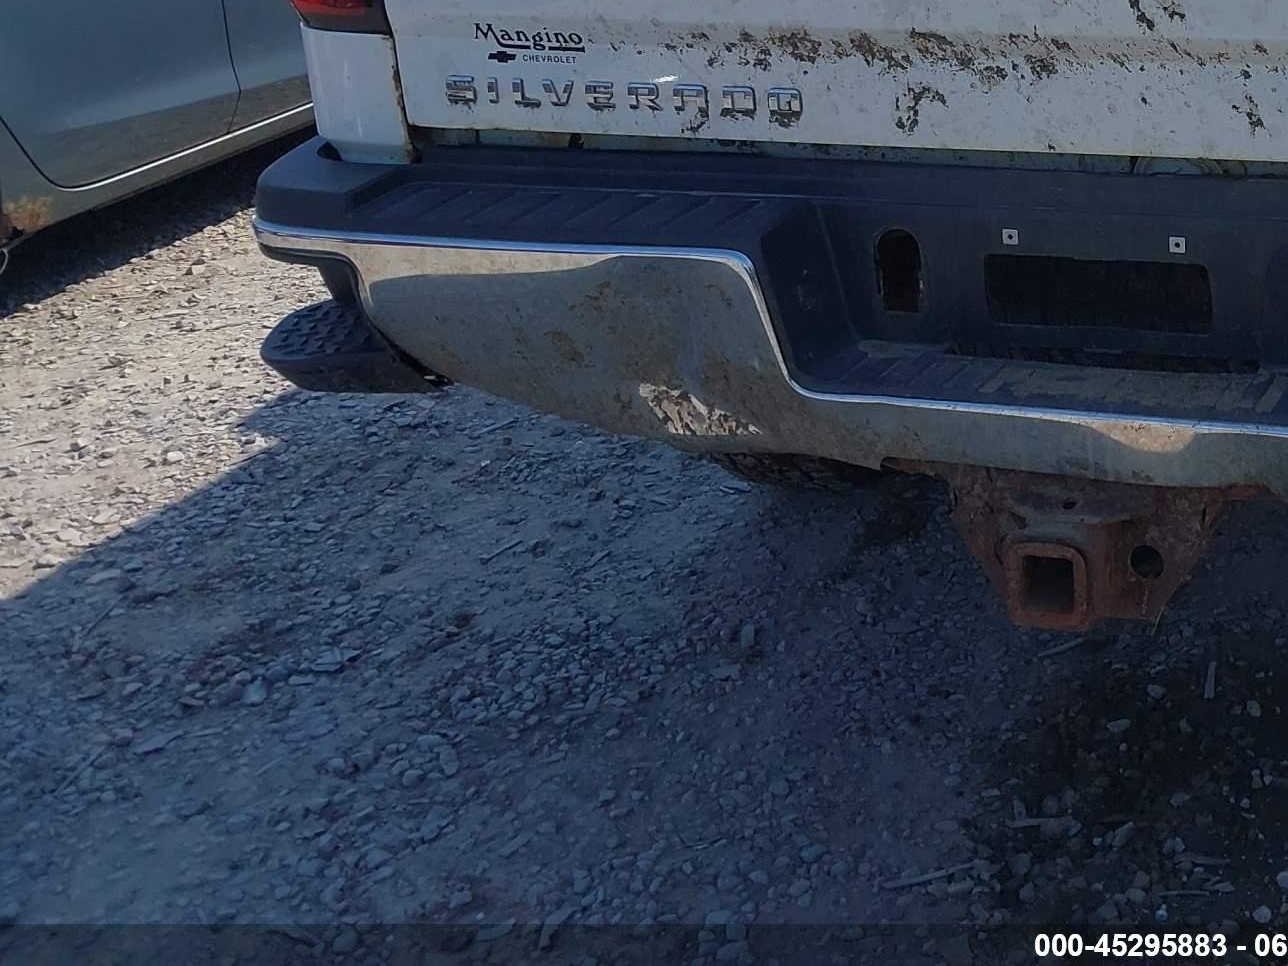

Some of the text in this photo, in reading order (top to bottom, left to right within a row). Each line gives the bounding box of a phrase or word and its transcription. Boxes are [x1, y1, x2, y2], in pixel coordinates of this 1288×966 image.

[473, 22, 584, 52] Mangino
[522, 54, 577, 65] CHEVROLET
[445, 74, 804, 119] SILVERADO
